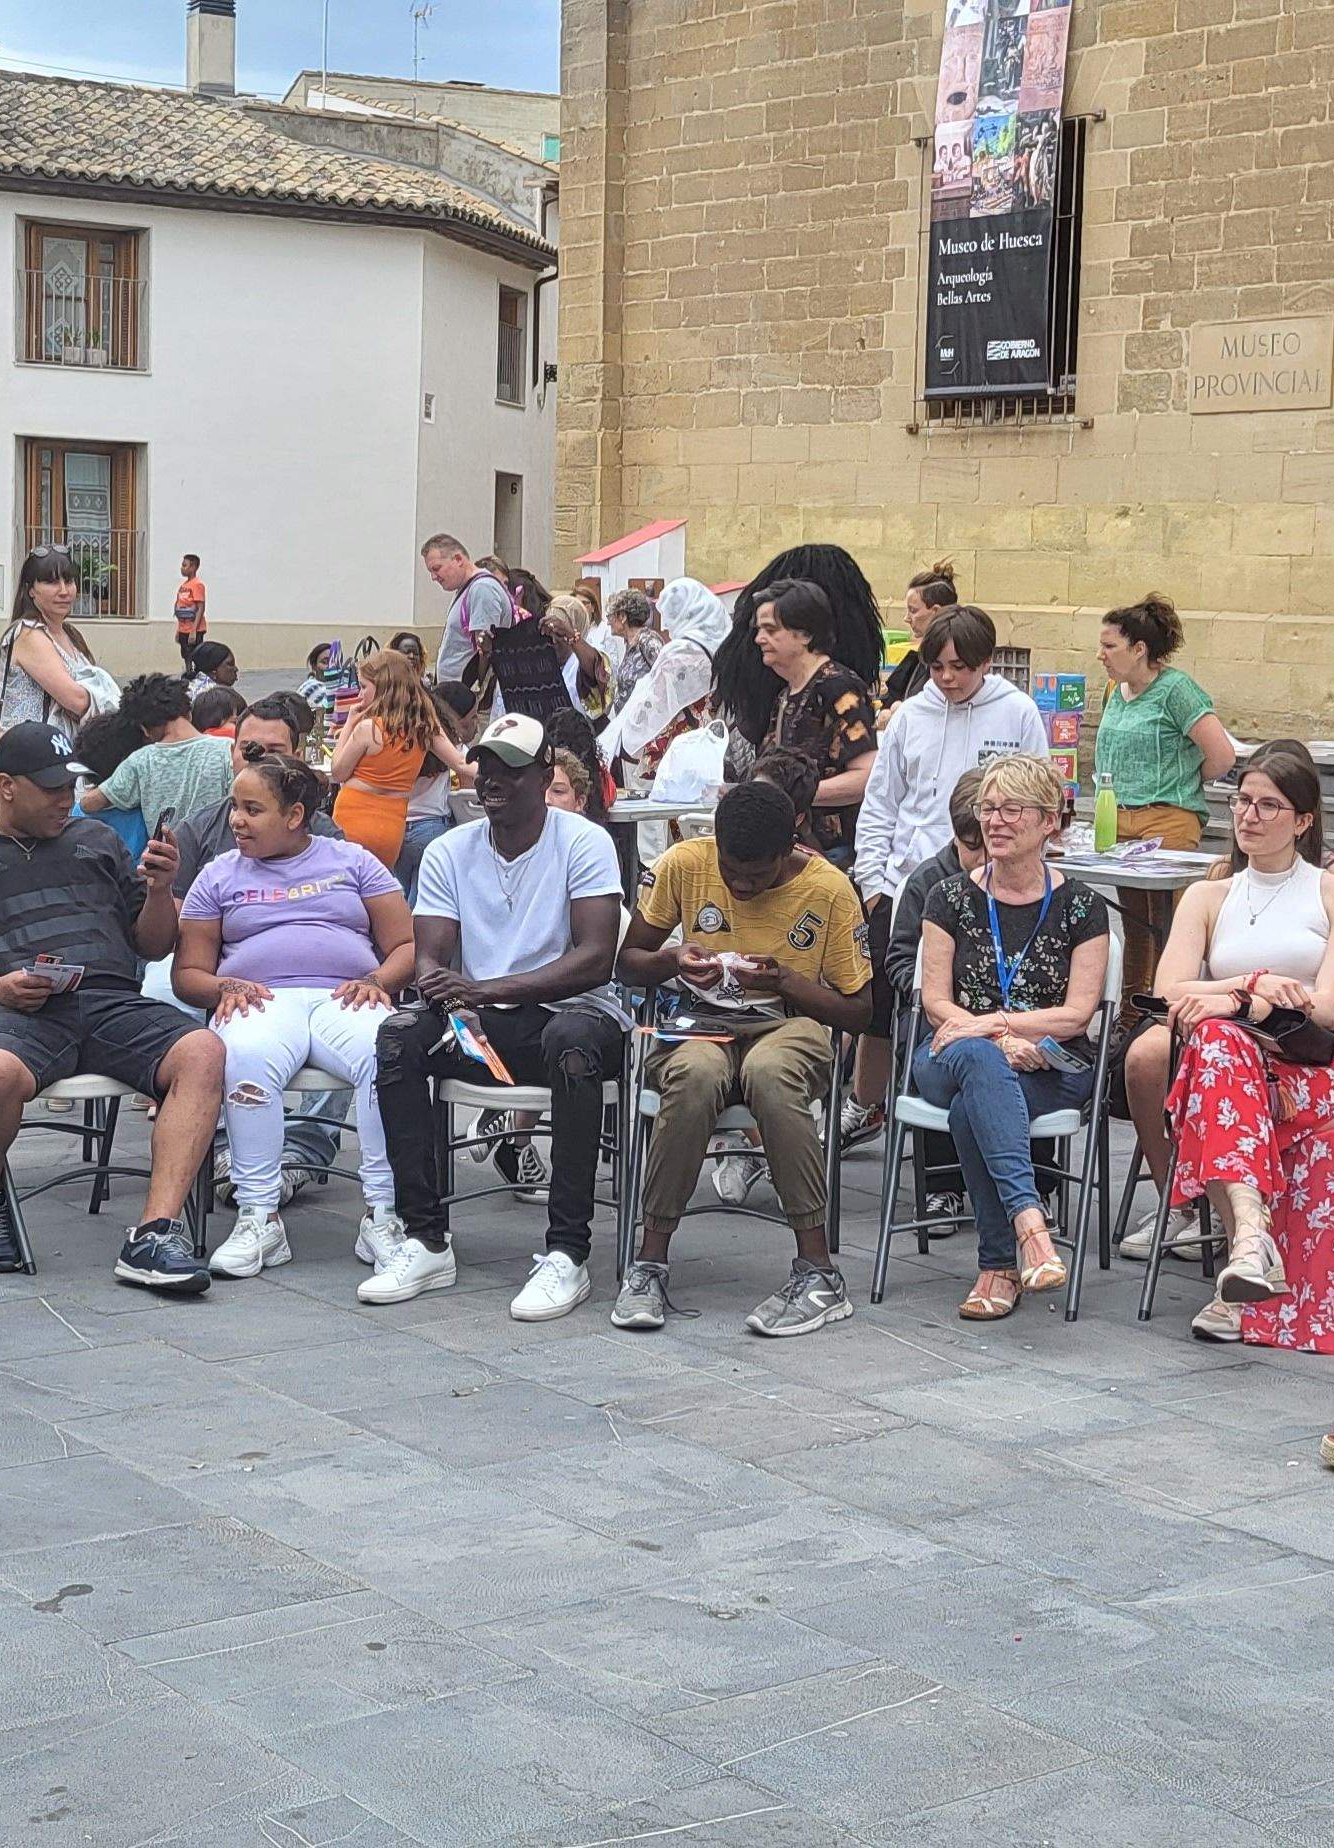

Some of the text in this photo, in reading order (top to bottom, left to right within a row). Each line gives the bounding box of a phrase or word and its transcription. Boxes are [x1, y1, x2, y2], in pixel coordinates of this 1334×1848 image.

[938, 231, 1043, 256] Museo de Huesca
[937, 266, 993, 288] Arqueología
[937, 290, 992, 306] Bellas Artes
[1220, 332, 1301, 360] MUSEO
[1194, 369, 1327, 399] PROVINCIAL
[510, 482, 518, 495] 6
[788, 908, 825, 950] 5
